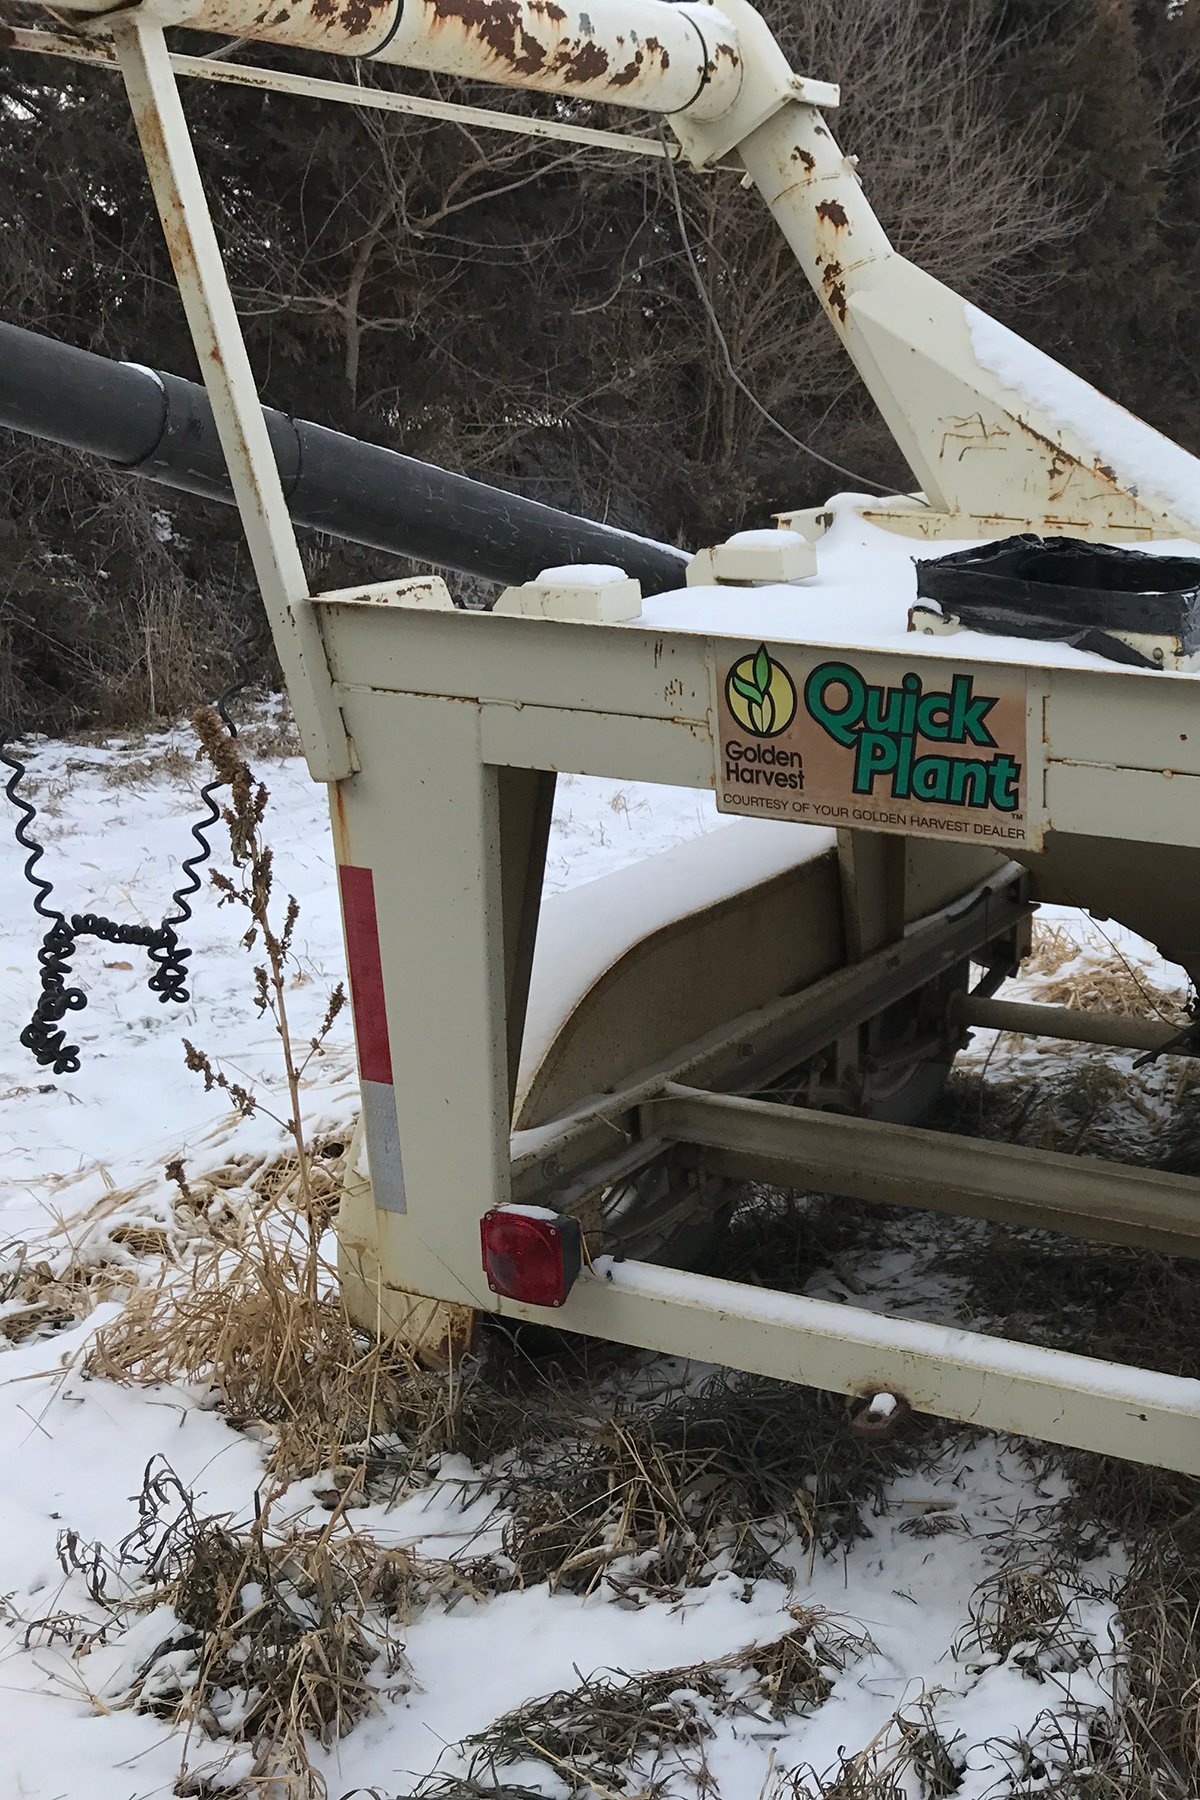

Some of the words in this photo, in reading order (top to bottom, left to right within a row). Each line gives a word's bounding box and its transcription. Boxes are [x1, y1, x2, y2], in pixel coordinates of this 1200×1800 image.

[804, 661, 1000, 748] Quick
[725, 740, 803, 768] Golden
[725, 762, 805, 790] Harvest
[852, 731, 1022, 812] Plant
[723, 794, 789, 811] COURTESY
[792, 801, 810, 813] OF
[813, 804, 849, 818] YOUR
[853, 809, 907, 825] GOLDEN
[911, 816, 970, 832] HARVEST
[974, 824, 1026, 840] DEALER
